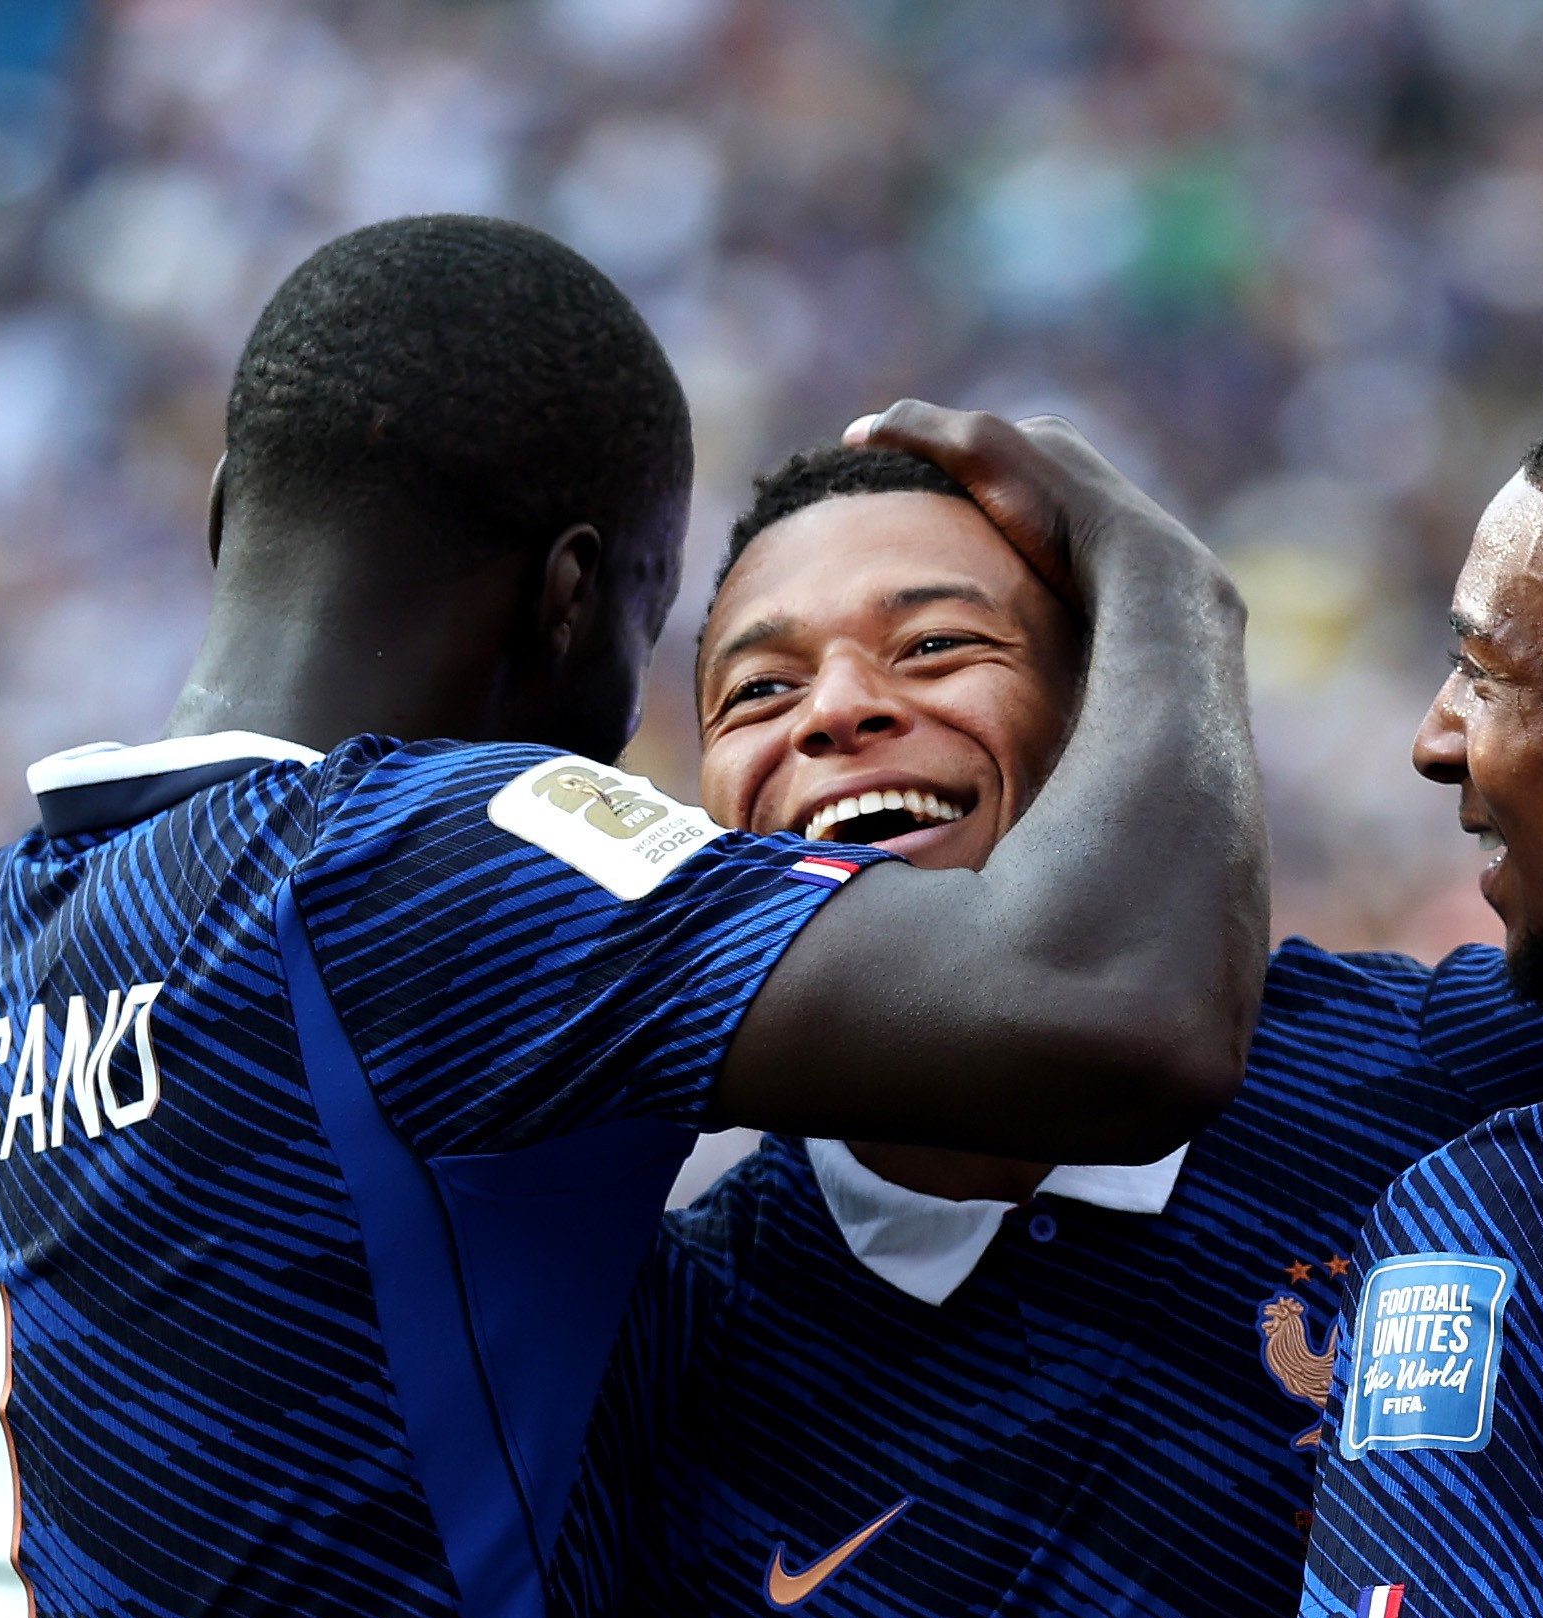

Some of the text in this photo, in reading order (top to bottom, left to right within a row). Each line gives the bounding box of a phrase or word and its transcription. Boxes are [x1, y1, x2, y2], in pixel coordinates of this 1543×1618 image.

[621, 807, 656, 828] FIFA
[631, 826, 670, 853] WORLD
[644, 825, 705, 865] 2026
[1376, 1283, 1473, 1319] FOOTBALL
[1371, 1313, 1472, 1359] UNITES
[1362, 1354, 1474, 1398] the World
